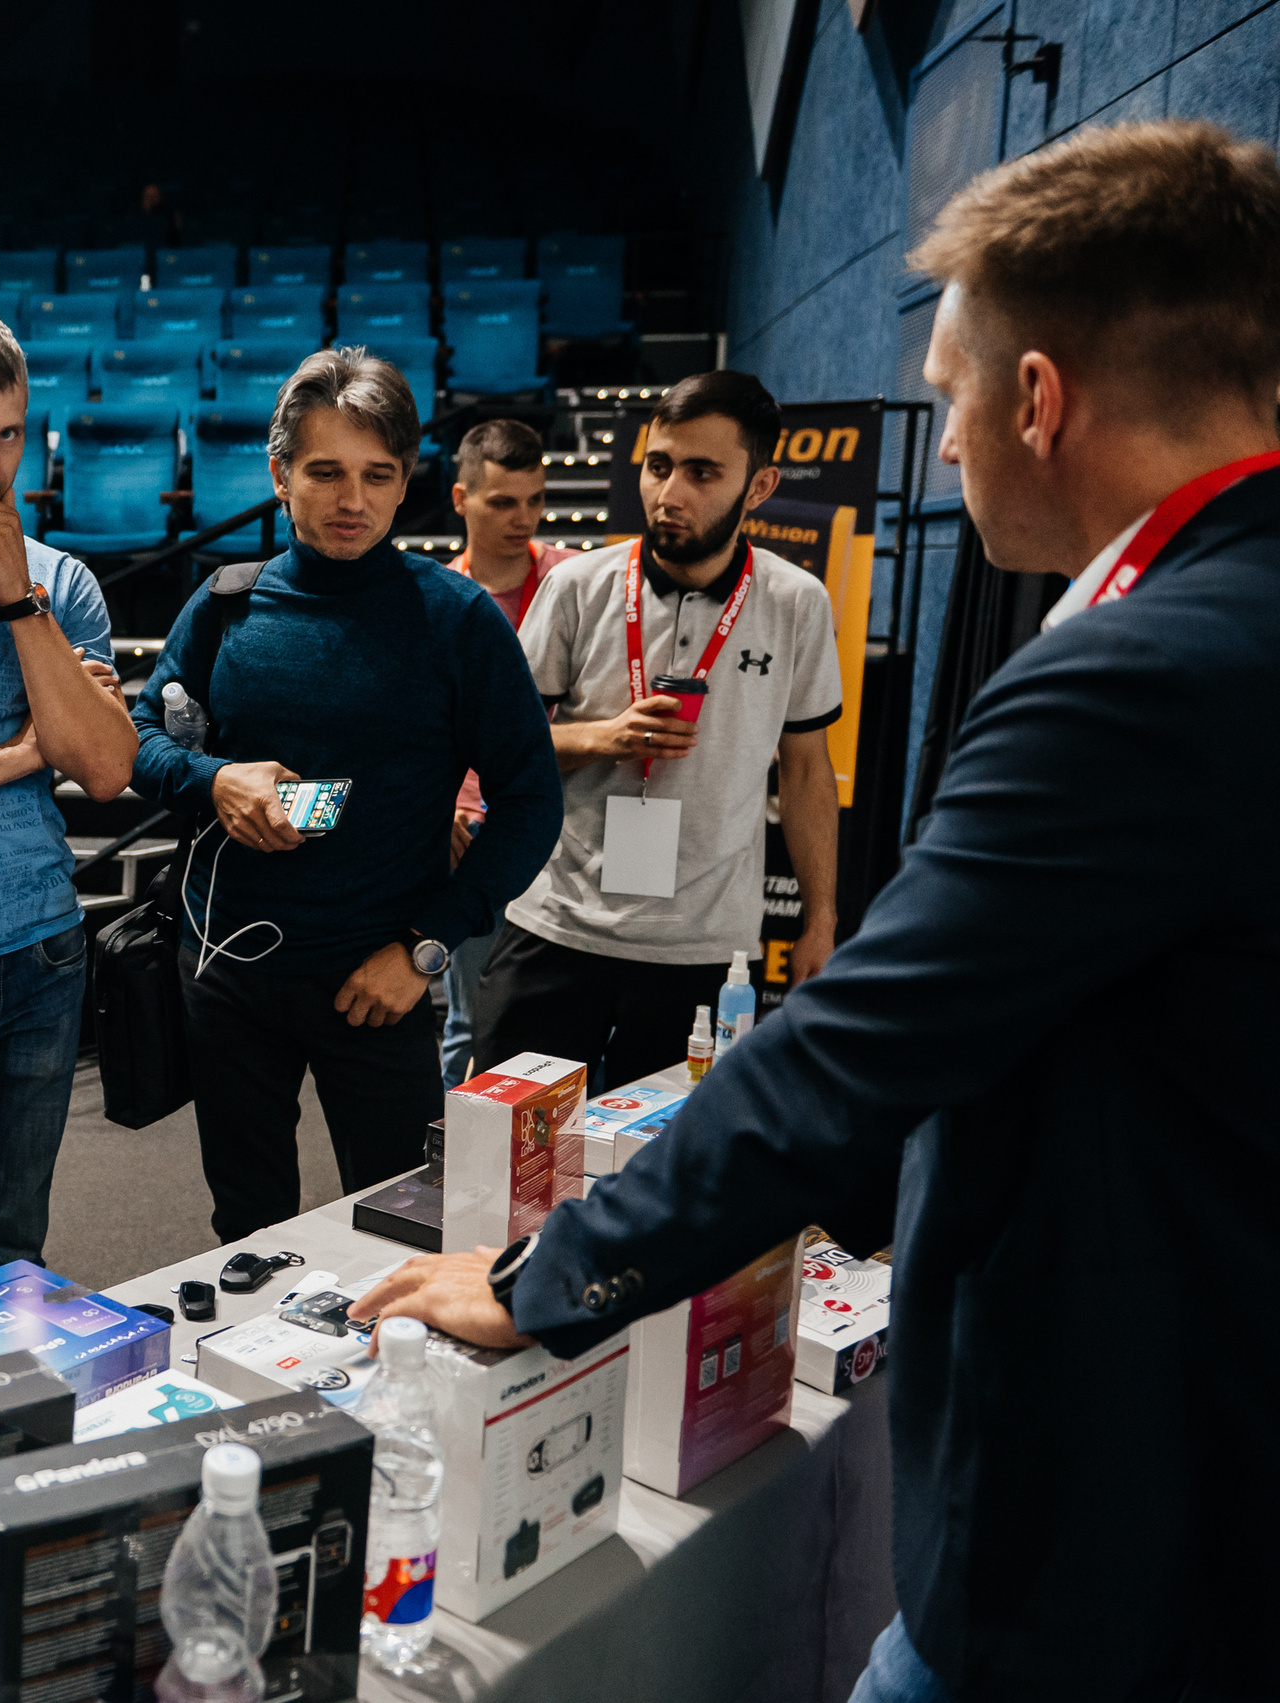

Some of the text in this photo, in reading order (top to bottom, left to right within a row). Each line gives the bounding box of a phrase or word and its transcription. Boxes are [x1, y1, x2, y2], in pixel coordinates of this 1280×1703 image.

[625, 558, 638, 613] Pandora
[721, 573, 751, 627] Pandora
[508, 1371, 546, 1397] Pandora
[33, 1451, 148, 1489] Pandora
